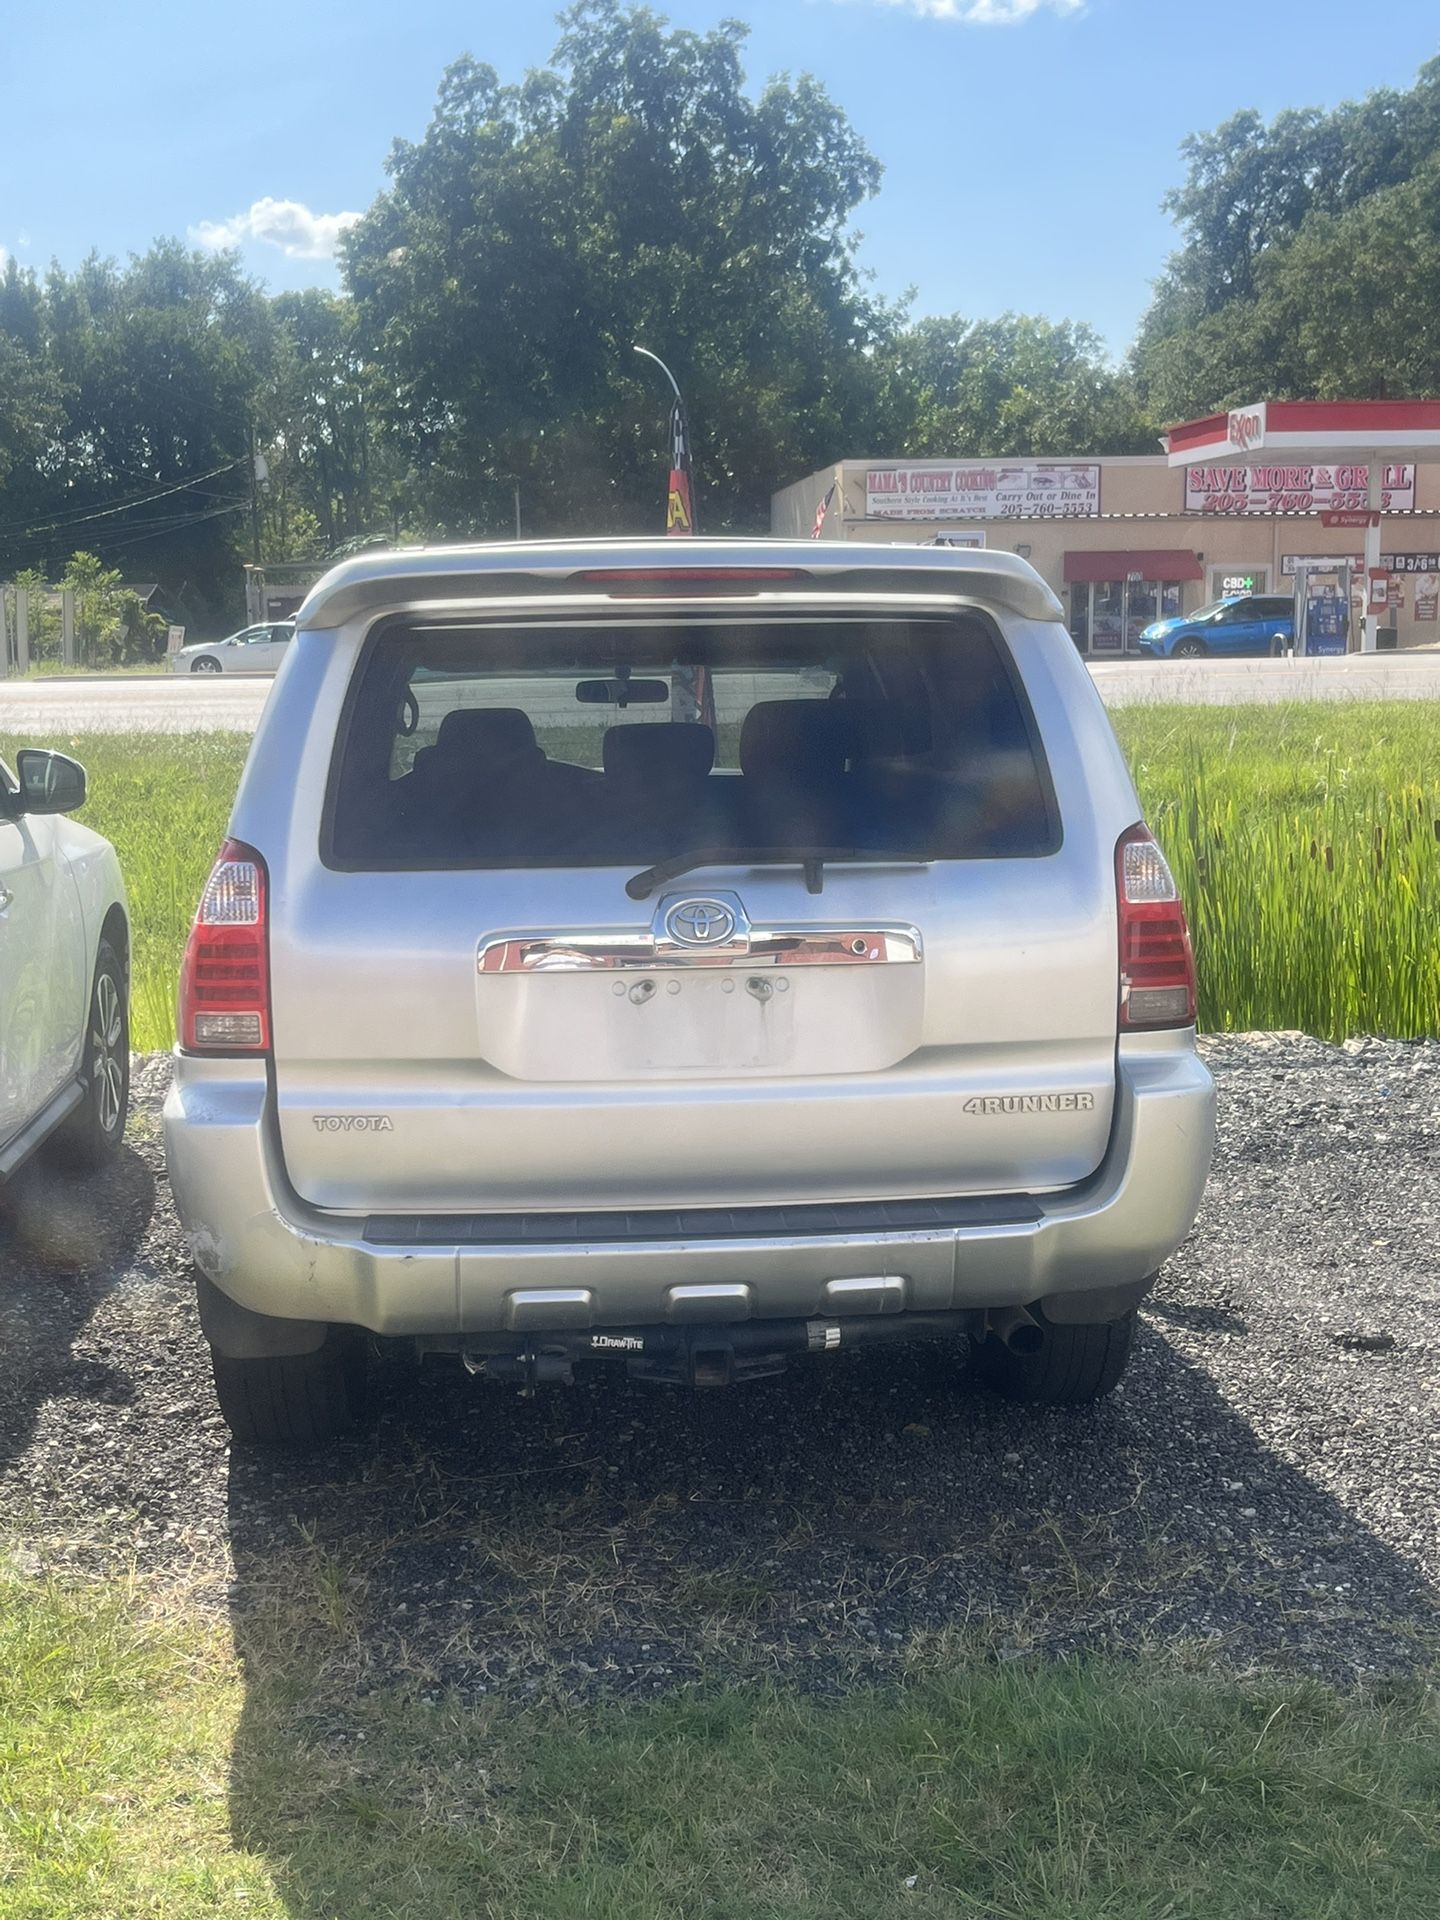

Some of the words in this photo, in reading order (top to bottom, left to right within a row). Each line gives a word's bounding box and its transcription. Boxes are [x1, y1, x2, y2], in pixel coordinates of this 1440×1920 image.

[868, 471, 908, 493] MAMA'S
[910, 471, 953, 493] COUNTRY
[955, 469, 995, 492] COOKING
[1190, 467, 1247, 492] SAVE
[1250, 466, 1313, 492] MORE
[1314, 468, 1334, 489] &
[1335, 465, 1412, 490] GRLL
[872, 496, 902, 505] Southern
[904, 496, 921, 505] Style
[922, 495, 948, 504] Cooking
[974, 494, 988, 502] Best
[995, 492, 1023, 502] Carry
[1026, 492, 1043, 501] Out
[1046, 493, 1057, 501] or
[1060, 491, 1082, 500] Dine
[1086, 491, 1096, 500] In
[1000, 503, 1093, 514] 205-760-5553
[1318, 646, 1345, 655] Synergy
[962, 1092, 1094, 1115] 4RUNNER
[312, 1115, 394, 1131] TOYOTA
